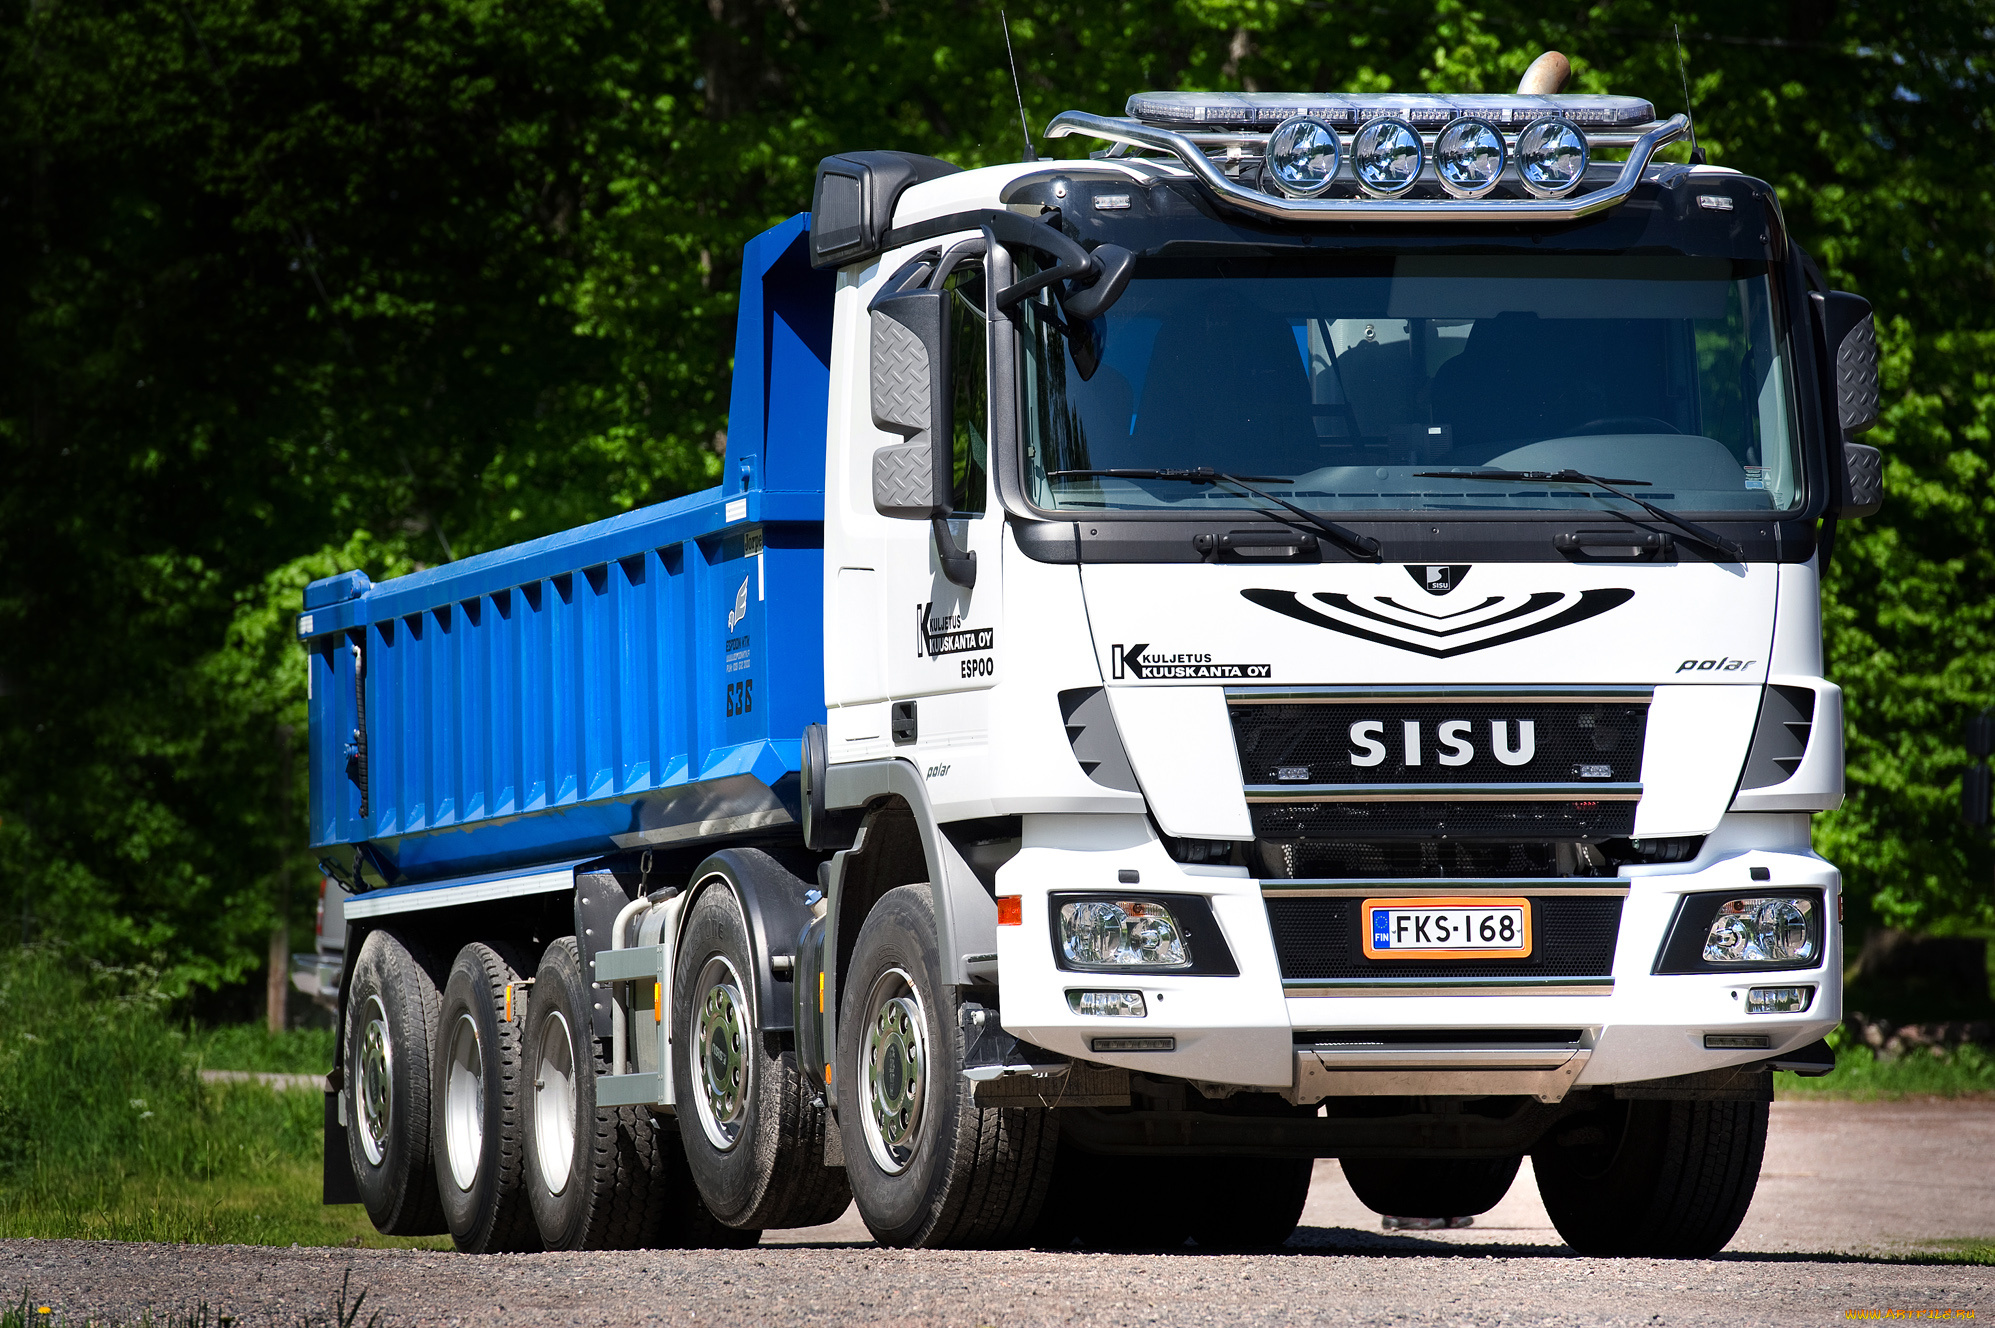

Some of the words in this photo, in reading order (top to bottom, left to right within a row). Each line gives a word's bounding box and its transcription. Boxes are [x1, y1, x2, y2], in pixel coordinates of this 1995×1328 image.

[929, 614, 961, 632] KULJETUS
[929, 633, 976, 654] KUUSKANTA
[978, 631, 992, 648] OY
[961, 657, 994, 679] ESPOO
[1143, 653, 1212, 664] KULJETUS
[1675, 656, 1757, 674] polar
[1142, 666, 1242, 678] KUUSKANTA
[1247, 665, 1270, 677] OY
[727, 679, 752, 717] 636
[1348, 719, 1536, 767] SISU
[926, 762, 951, 782] polar
[1375, 933, 1389, 942] FIN
[1396, 915, 1515, 943] FKS-168
